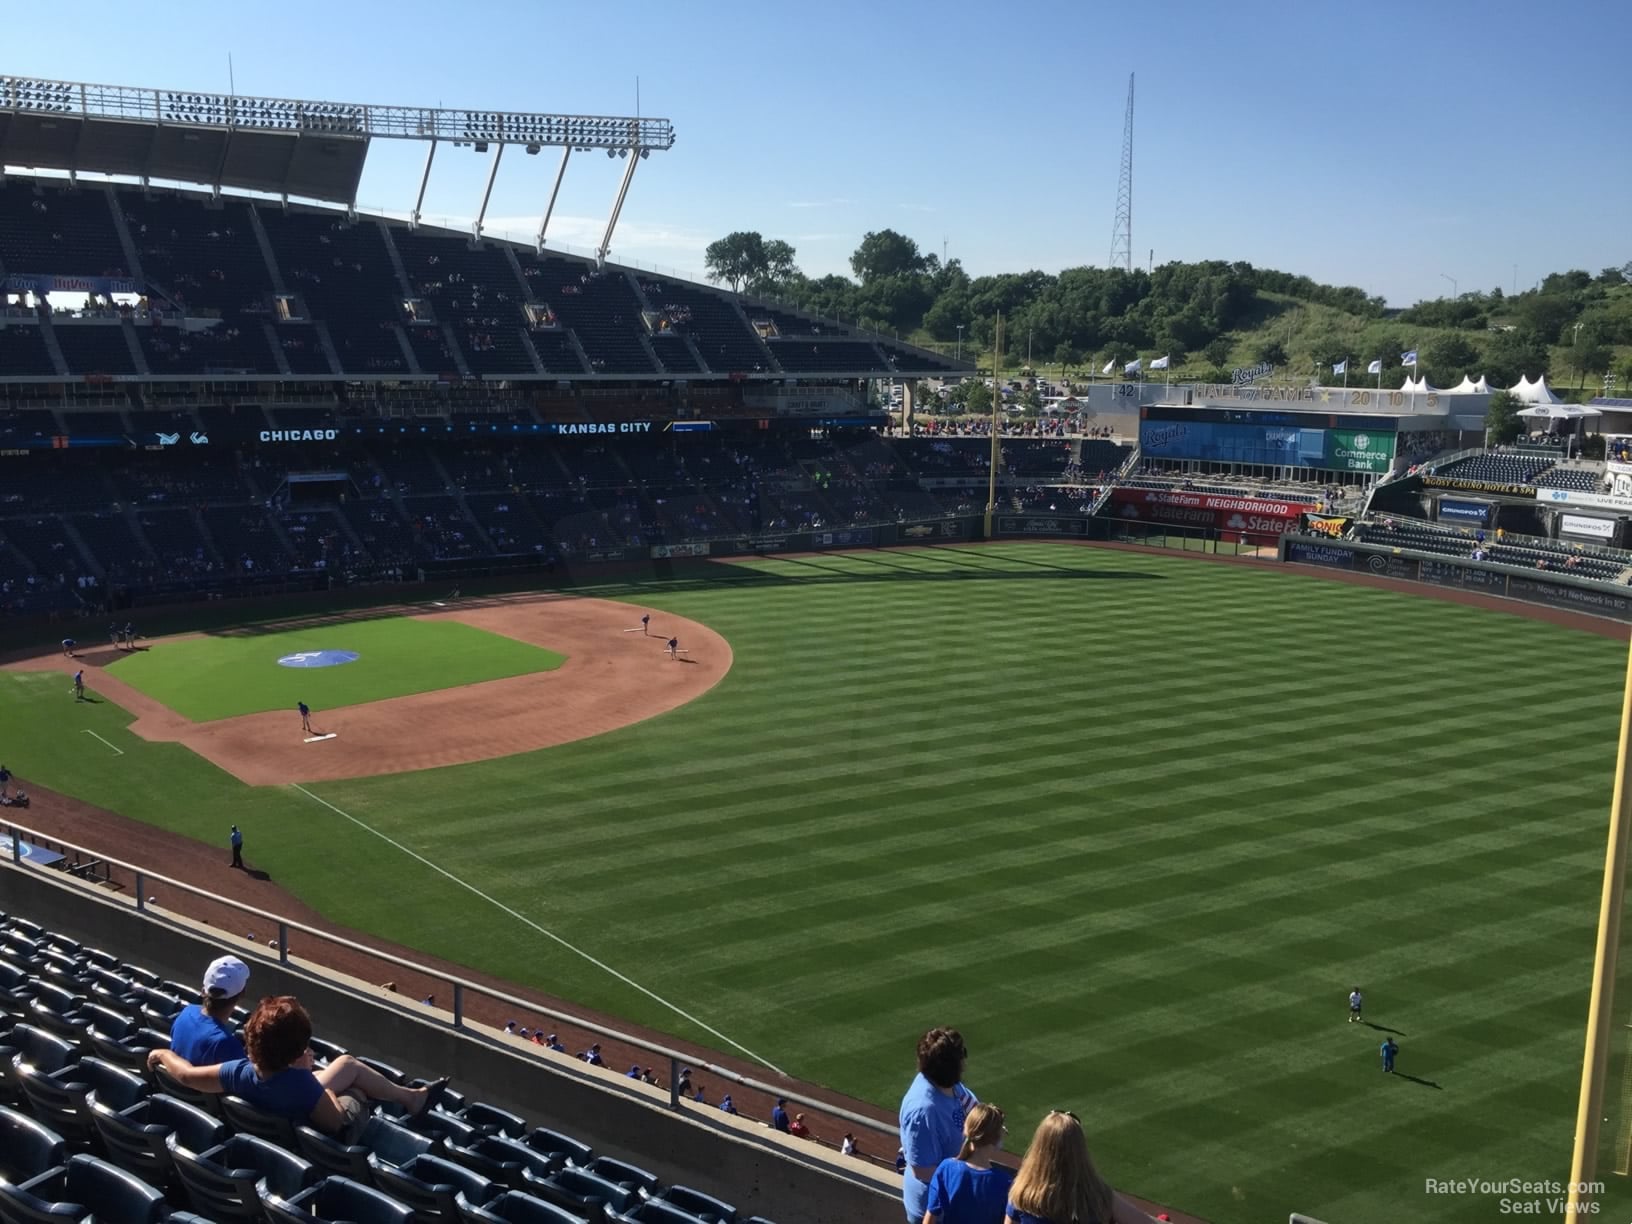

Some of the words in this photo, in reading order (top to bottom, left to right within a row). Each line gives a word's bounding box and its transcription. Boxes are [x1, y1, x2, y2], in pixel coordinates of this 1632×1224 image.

[1232, 363, 1273, 386] Royals
[1119, 384, 1134, 397] 42
[1195, 384, 1241, 400] HALL
[1261, 385, 1313, 402] FAME
[1351, 391, 1370, 405] 20
[1388, 391, 1404, 406] 10
[1427, 393, 1438, 407] 5
[559, 423, 616, 435] KANSAS
[620, 422, 651, 433] CITY
[260, 430, 336, 442] CHICAGO
[1144, 423, 1187, 448] Royals
[1335, 448, 1387, 461] Commerce
[1347, 459, 1373, 470] Bank
[1452, 480, 1482, 490] CASINO
[1484, 483, 1511, 493] HOTEL
[1520, 487, 1535, 495] SPA
[1206, 498, 1288, 514] NEIGHBORHOOD
[1442, 507, 1478, 516] GRUNDFOS
[1310, 520, 1343, 532] SONIC
[1563, 521, 1602, 531] GRUNDFOS
[1291, 543, 1320, 554] FAMILY
[1321, 547, 1353, 558] FUNDAY
[1306, 552, 1339, 563] SUNDAY
[1568, 591, 1603, 604] Network
